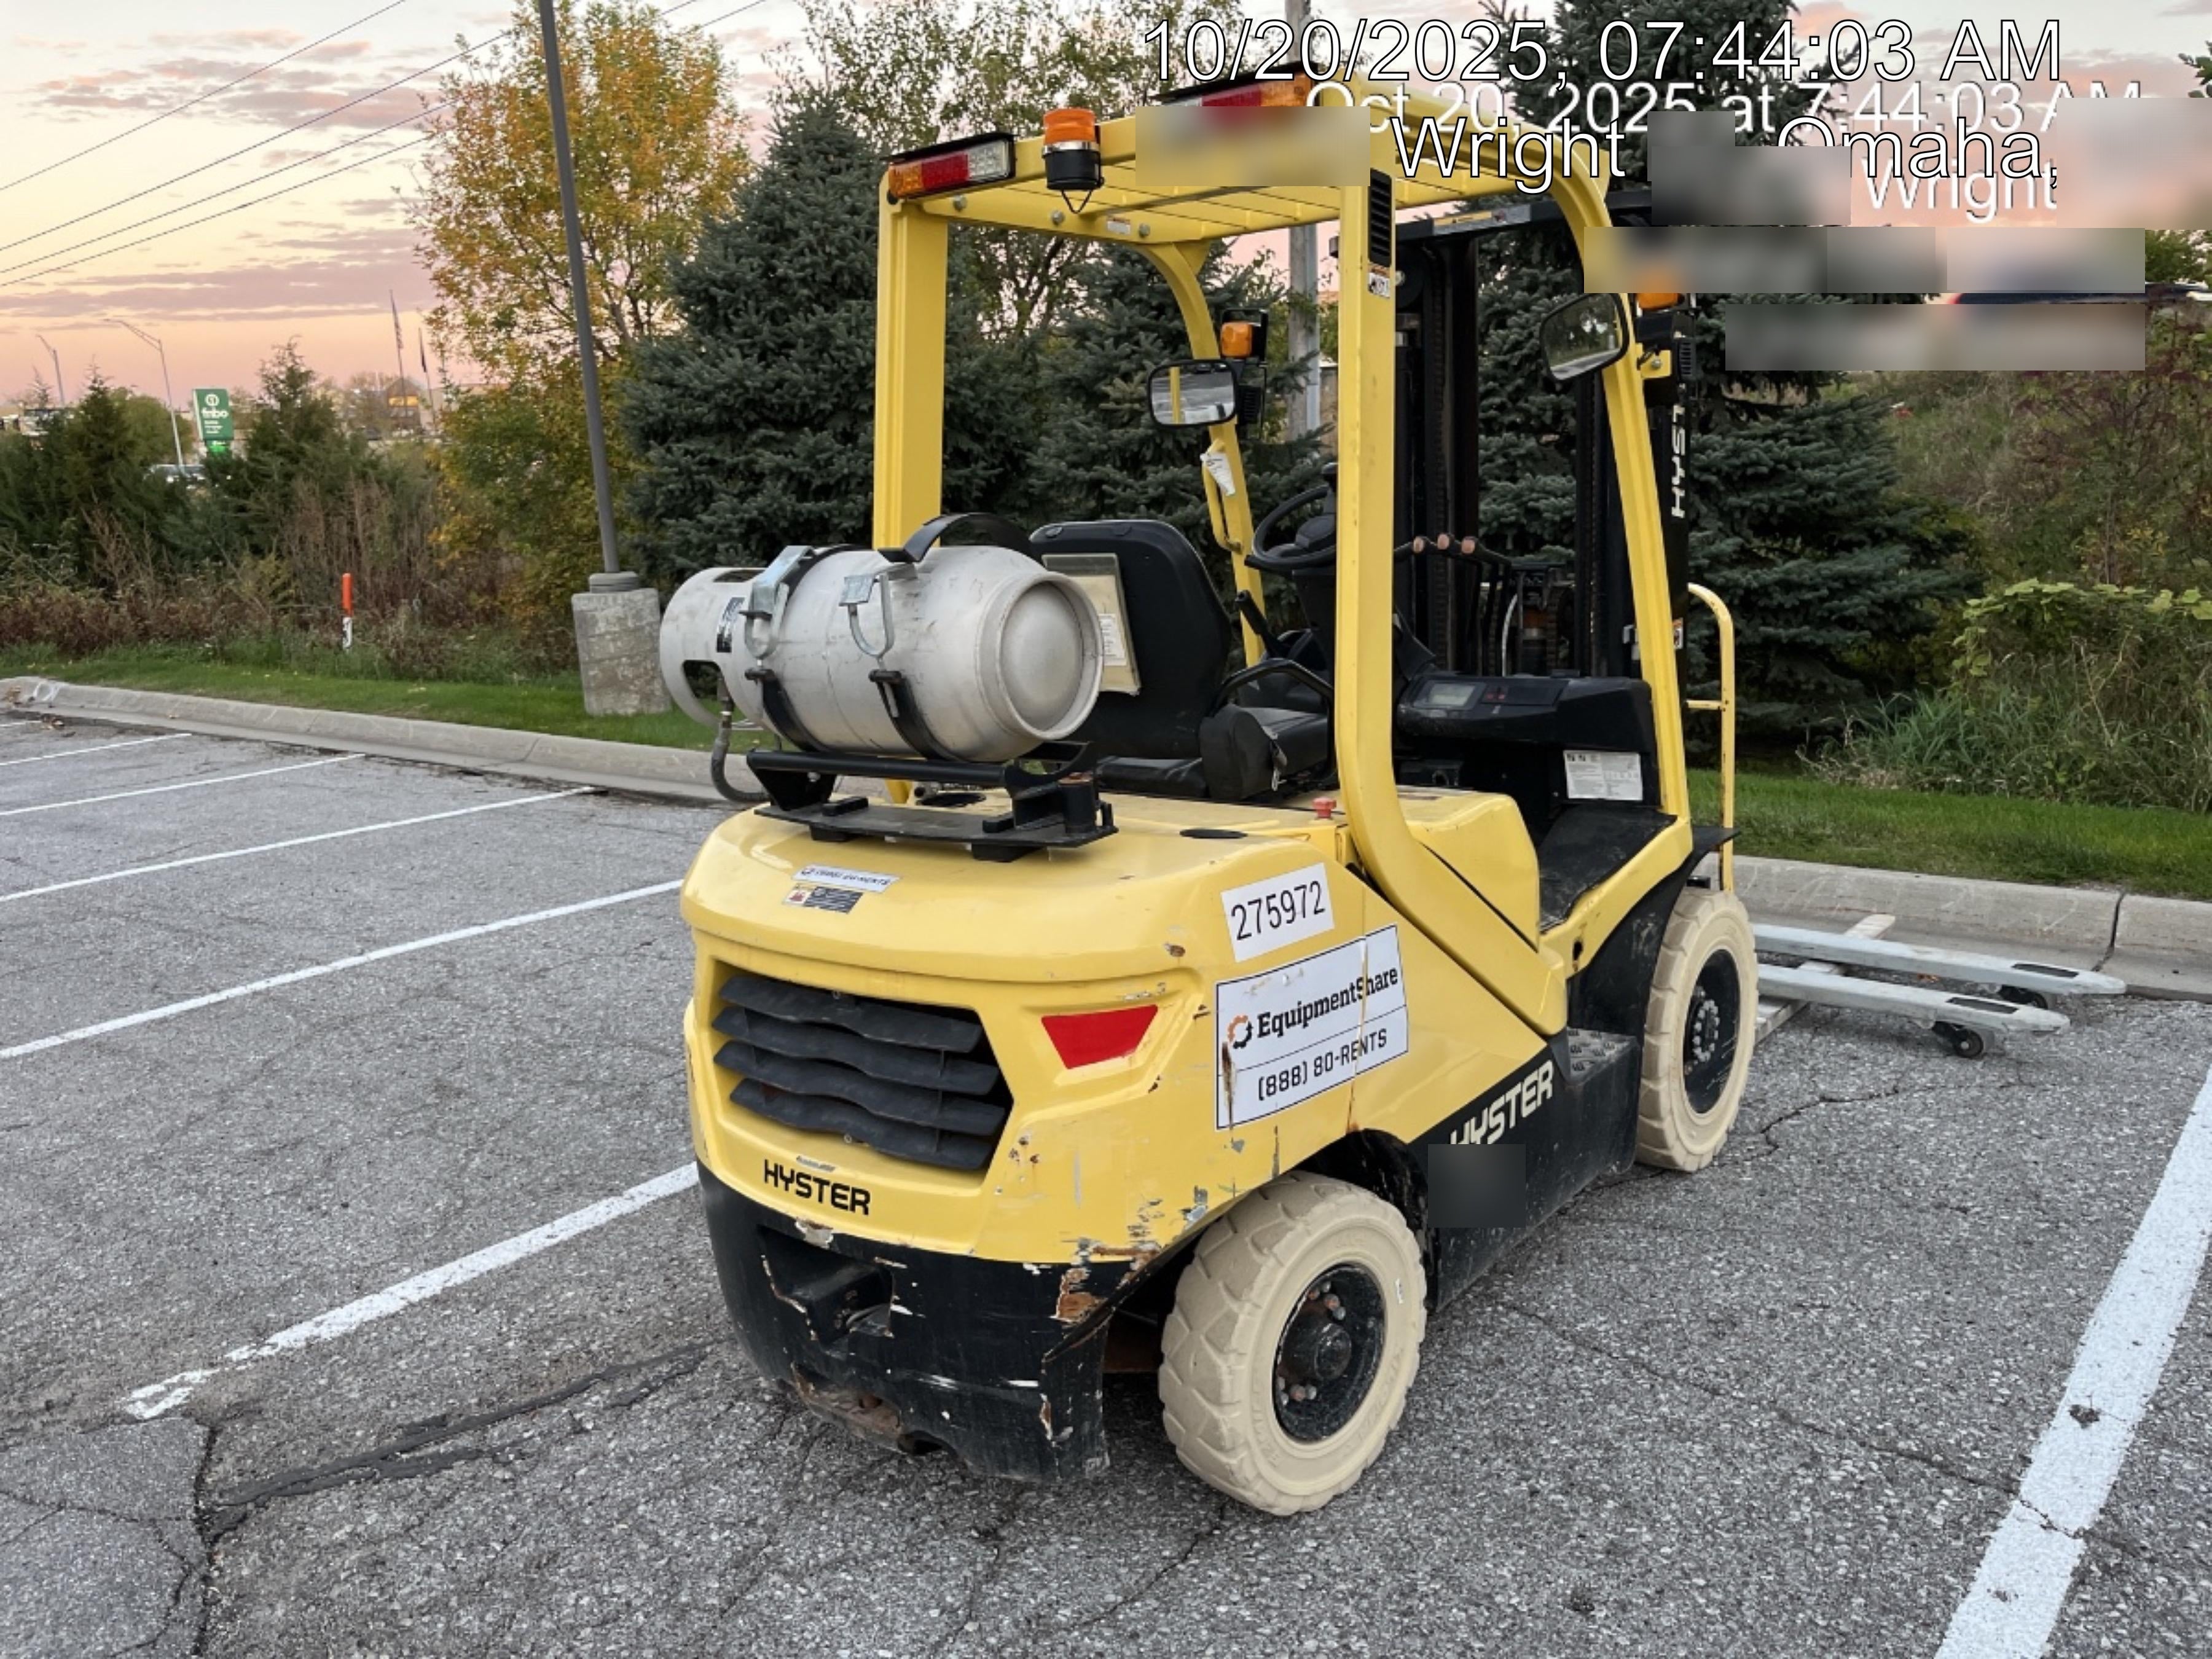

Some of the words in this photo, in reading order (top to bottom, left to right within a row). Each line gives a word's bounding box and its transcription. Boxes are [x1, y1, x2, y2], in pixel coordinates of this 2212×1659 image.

[1231, 880, 1326, 940] 275972
[1257, 967, 1398, 1038] EquipmentShare
[1258, 1061, 1308, 1101] (888)
[1313, 1028, 1387, 1077] 80-RENTS
[764, 1159, 871, 1216] HYSTER
